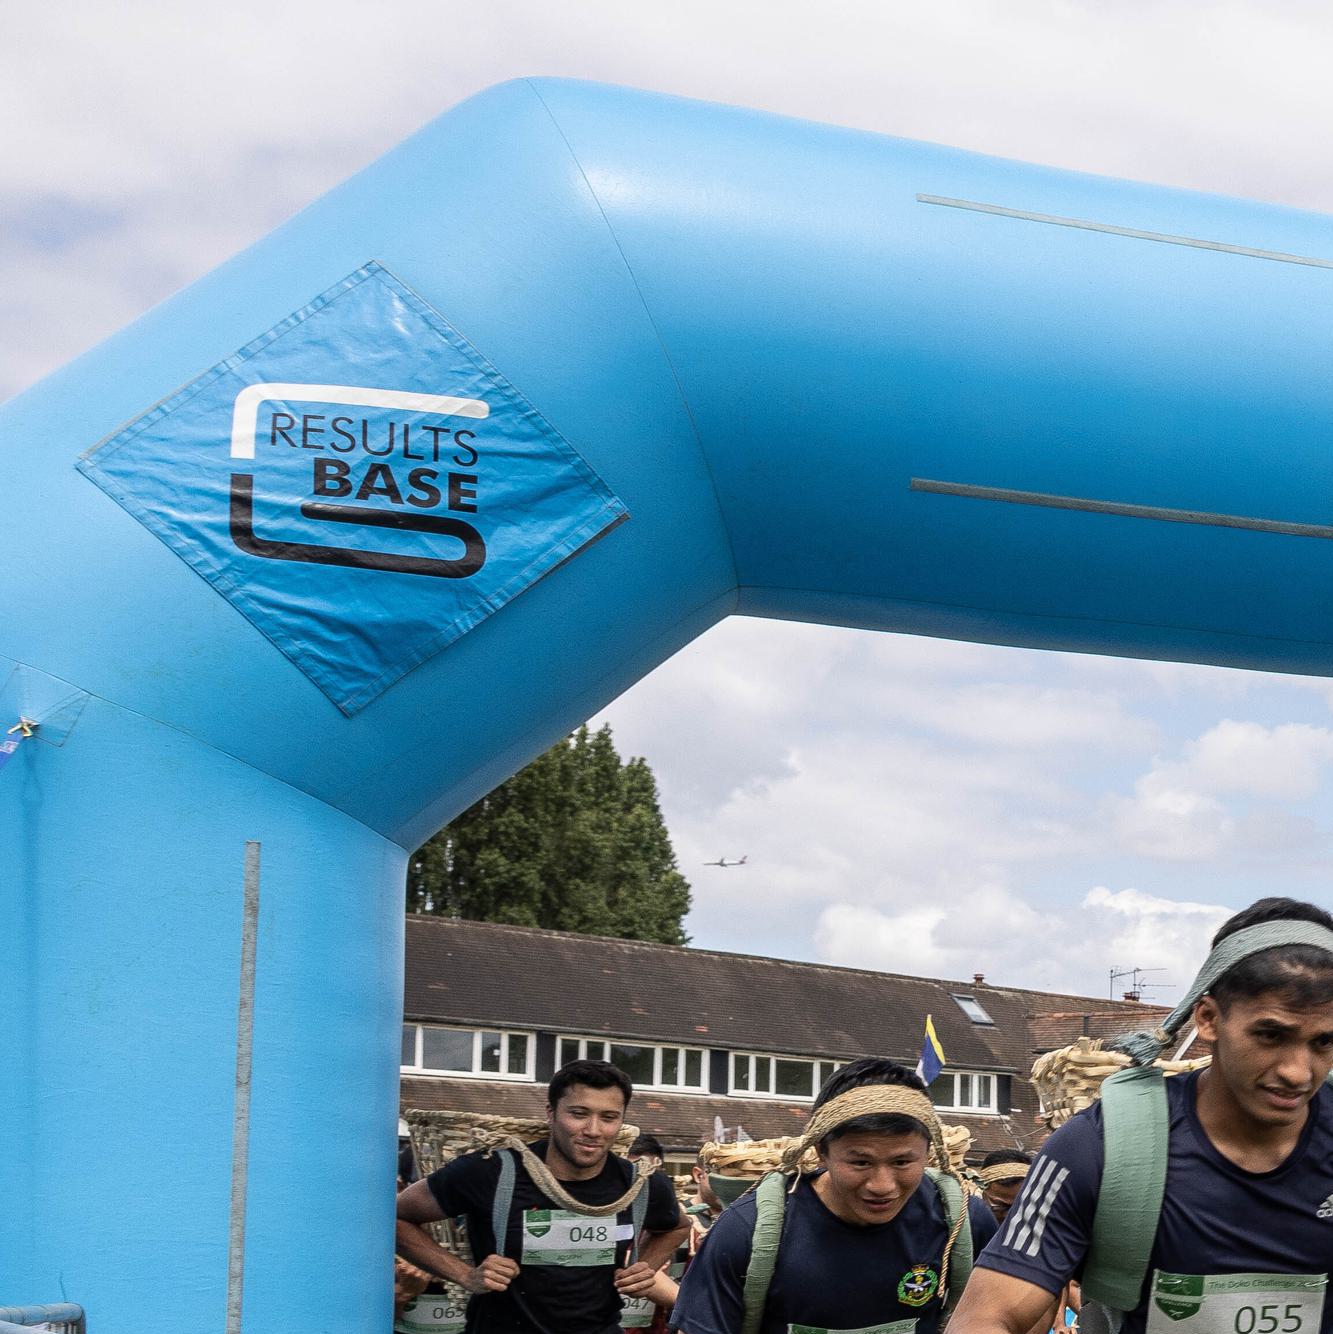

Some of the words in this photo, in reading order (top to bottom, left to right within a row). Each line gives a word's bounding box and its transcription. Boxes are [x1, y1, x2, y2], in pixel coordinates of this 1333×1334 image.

[269, 411, 479, 467] RESULTS
[313, 457, 479, 514] BASE
[569, 1226, 608, 1243] 048
